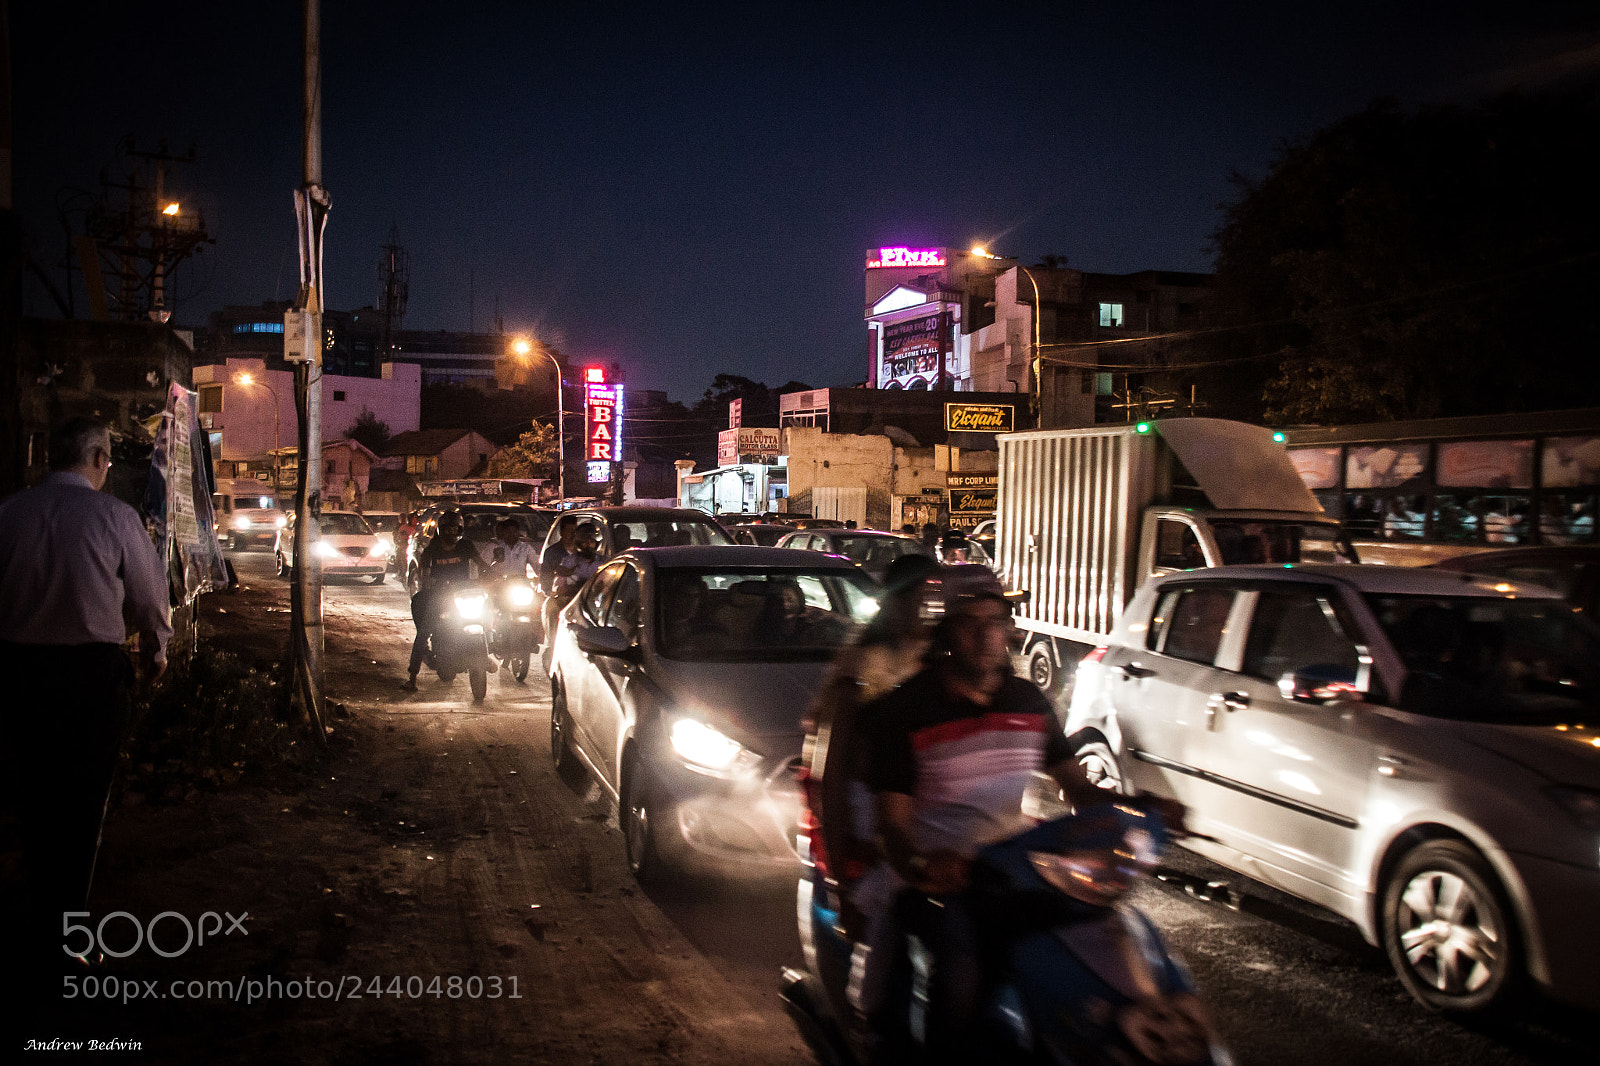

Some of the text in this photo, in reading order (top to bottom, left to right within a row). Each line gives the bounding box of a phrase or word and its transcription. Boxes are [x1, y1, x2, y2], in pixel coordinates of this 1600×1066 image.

[880, 248, 938, 262] PINK
[894, 350, 920, 361] WELCOME
[920, 348, 928, 357] TO
[951, 409, 1005, 429] Elegant
[592, 406, 612, 459] BAR
[739, 435, 778, 444] CALCUTTA
[948, 477, 964, 485] MRF
[965, 477, 984, 485] CORP
